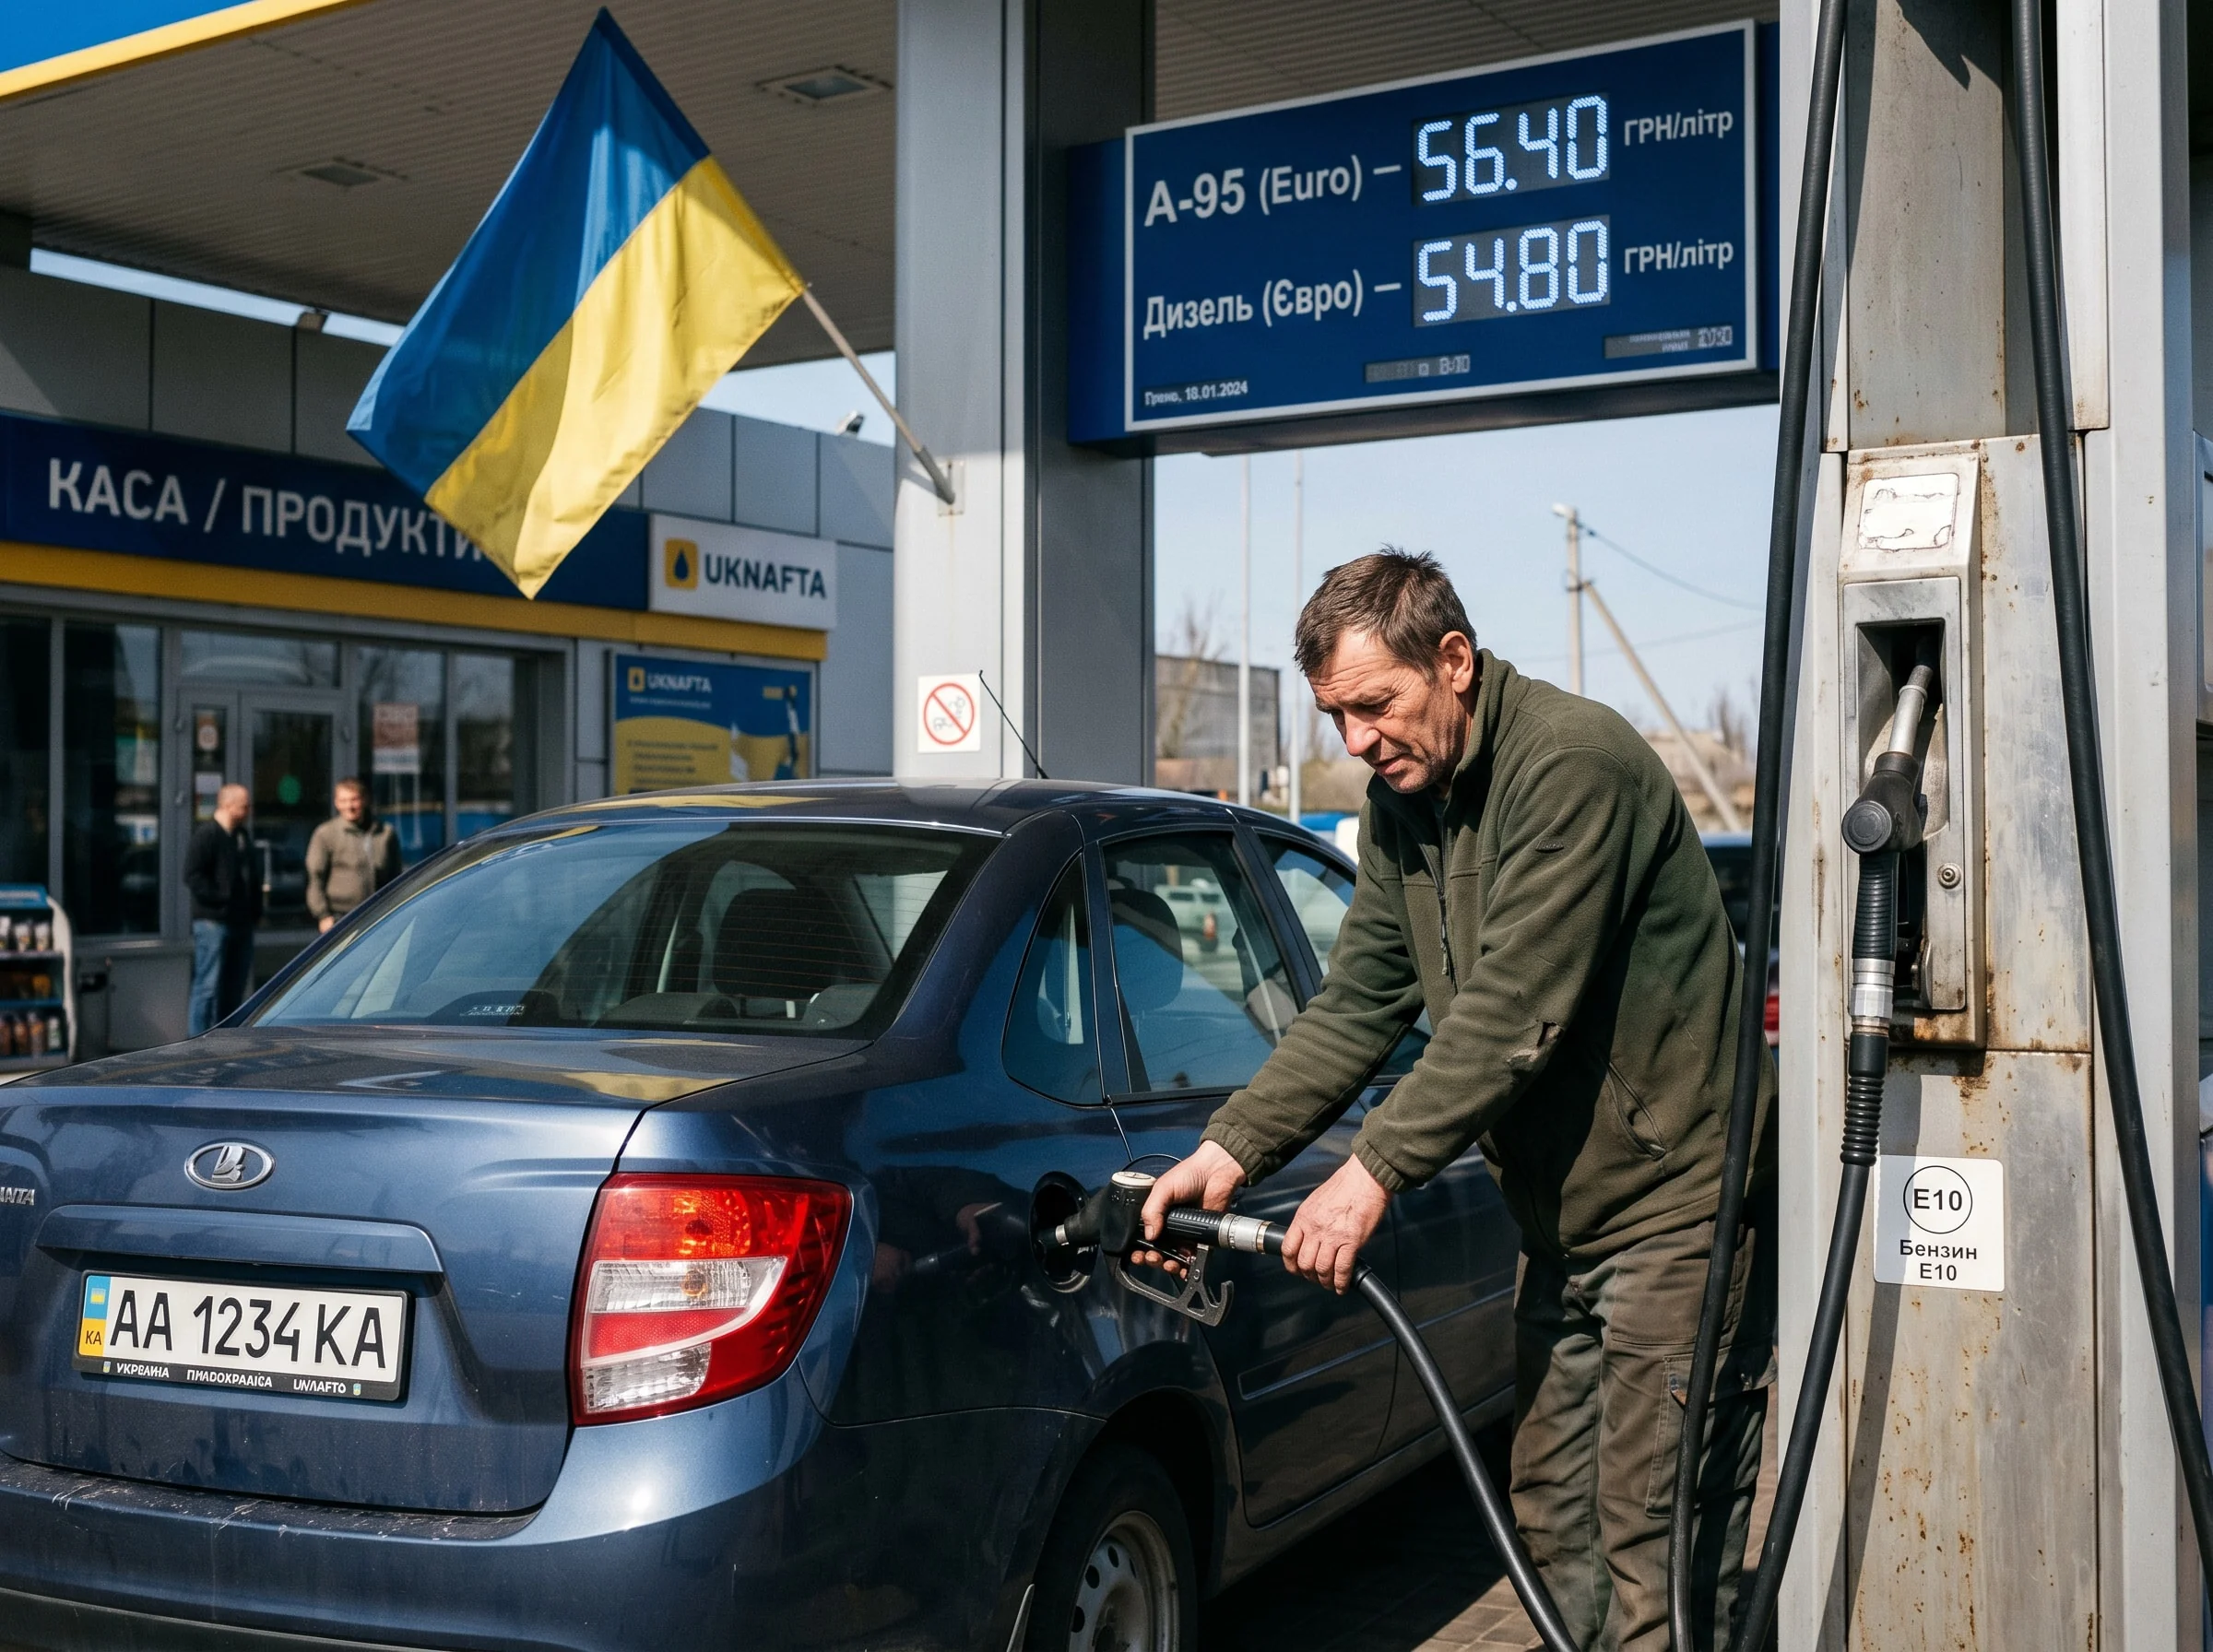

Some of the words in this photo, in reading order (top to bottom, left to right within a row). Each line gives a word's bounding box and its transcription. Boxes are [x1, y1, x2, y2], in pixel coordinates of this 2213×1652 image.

[1144, 169, 1245, 227] A-95
[1260, 155, 1362, 216] (Euro)
[1417, 95, 1608, 203] 56.40
[1625, 108, 1734, 147] ГРН/літр
[1143, 291, 1253, 339] Дизель
[1262, 269, 1363, 328] (Євро)
[1417, 218, 1608, 323] 54.80
[1625, 238, 1734, 275] ГРН/літр
[49, 458, 188, 525] КАСА
[705, 553, 827, 600] UKNAFTA
[647, 673, 712, 693] UKNAFTA
[1913, 1188, 1963, 1211] E10
[1899, 1239, 1978, 1260] Бензин
[1920, 1263, 1957, 1281] E10
[85, 1330, 102, 1346] KA
[110, 1290, 172, 1351] AA
[193, 1295, 301, 1363] 1234
[314, 1304, 385, 1369] KA
